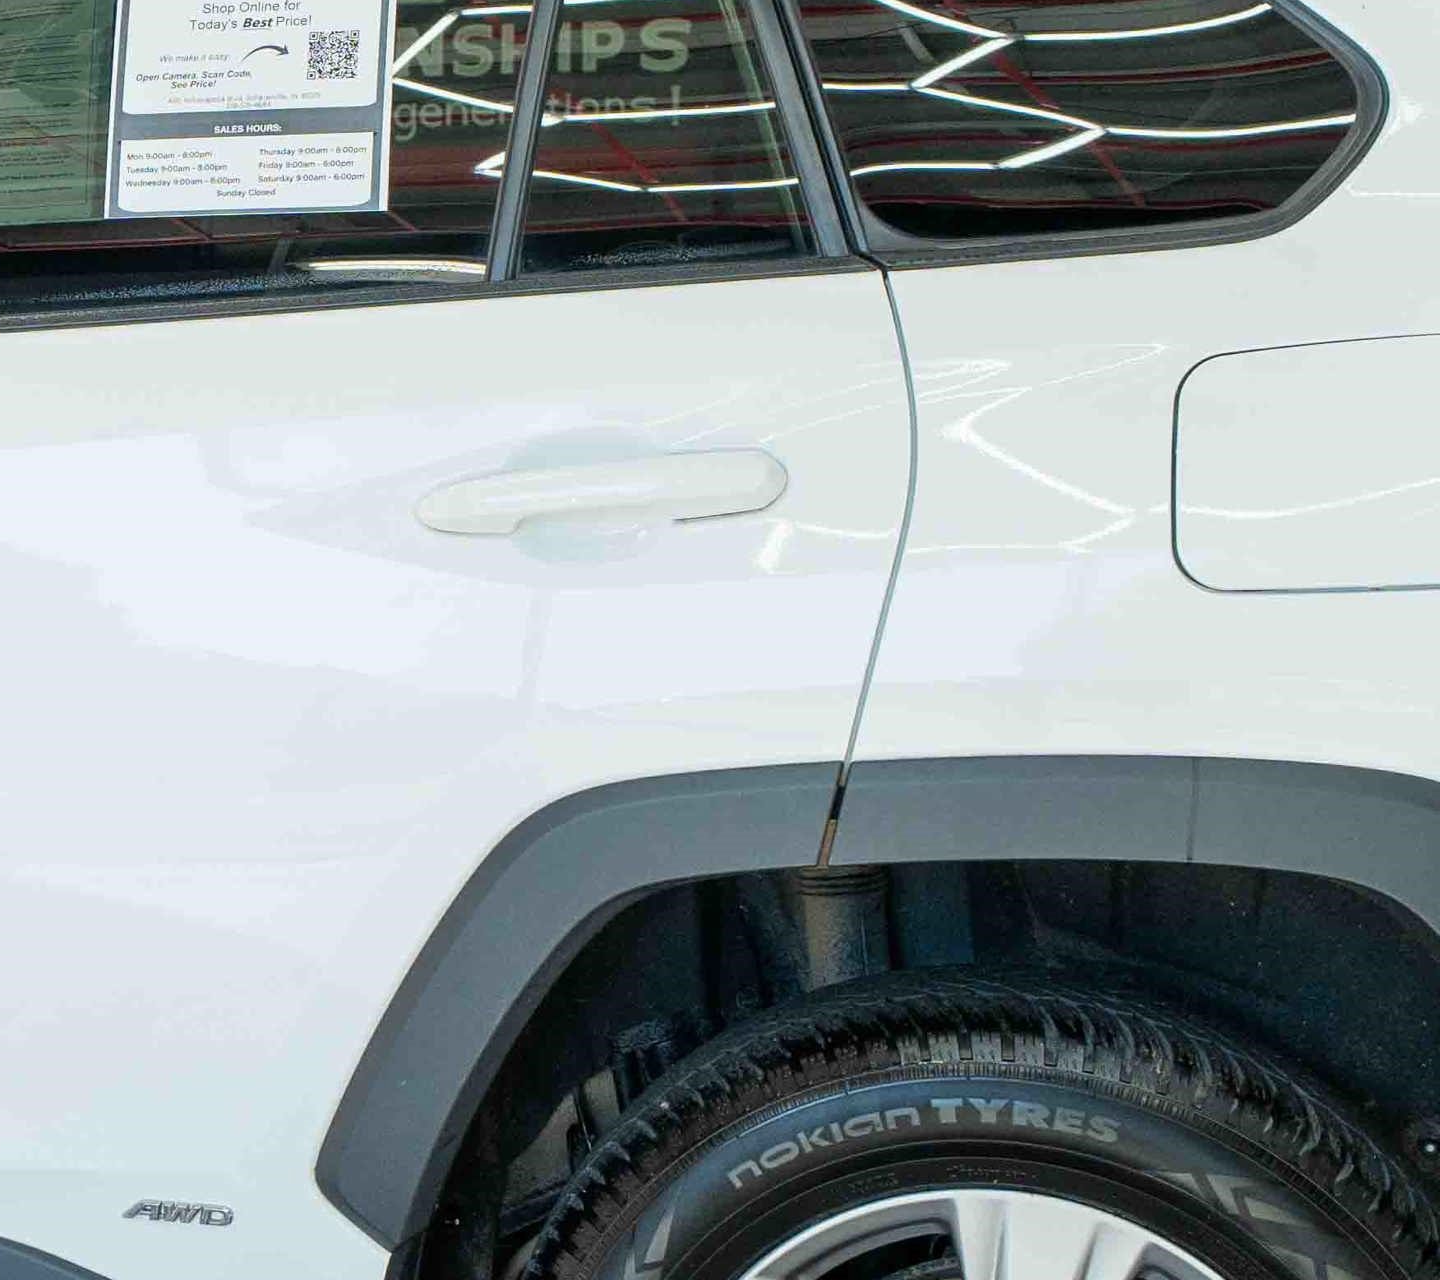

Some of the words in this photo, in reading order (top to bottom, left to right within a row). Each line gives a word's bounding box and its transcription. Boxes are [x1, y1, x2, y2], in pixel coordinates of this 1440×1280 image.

[203, 3, 235, 15] Shop
[239, 1, 280, 13] Online
[284, 0, 301, 11] for
[190, 18, 238, 31] Today's
[243, 18, 273, 29] Best
[276, 15, 313, 27] Price!
[136, 73, 160, 83] Open
[201, 70, 225, 80] Scan
[171, 81, 188, 90] See
[190, 79, 218, 89] Price!
[214, 125, 244, 134] SALES
[247, 123, 283, 133] HOURS:
[127, 153, 144, 161] Mon
[259, 148, 296, 157] Thursday
[126, 166, 159, 175] Tuesday
[258, 161, 283, 170] Friday
[125, 179, 171, 188] Wednesday
[258, 174, 294, 184] Saturday
[217, 189, 246, 198] Sunday
[248, 188, 277, 197] Closed
[930, 1097, 1122, 1144] TYRES
[121, 1198, 235, 1227] AWD
